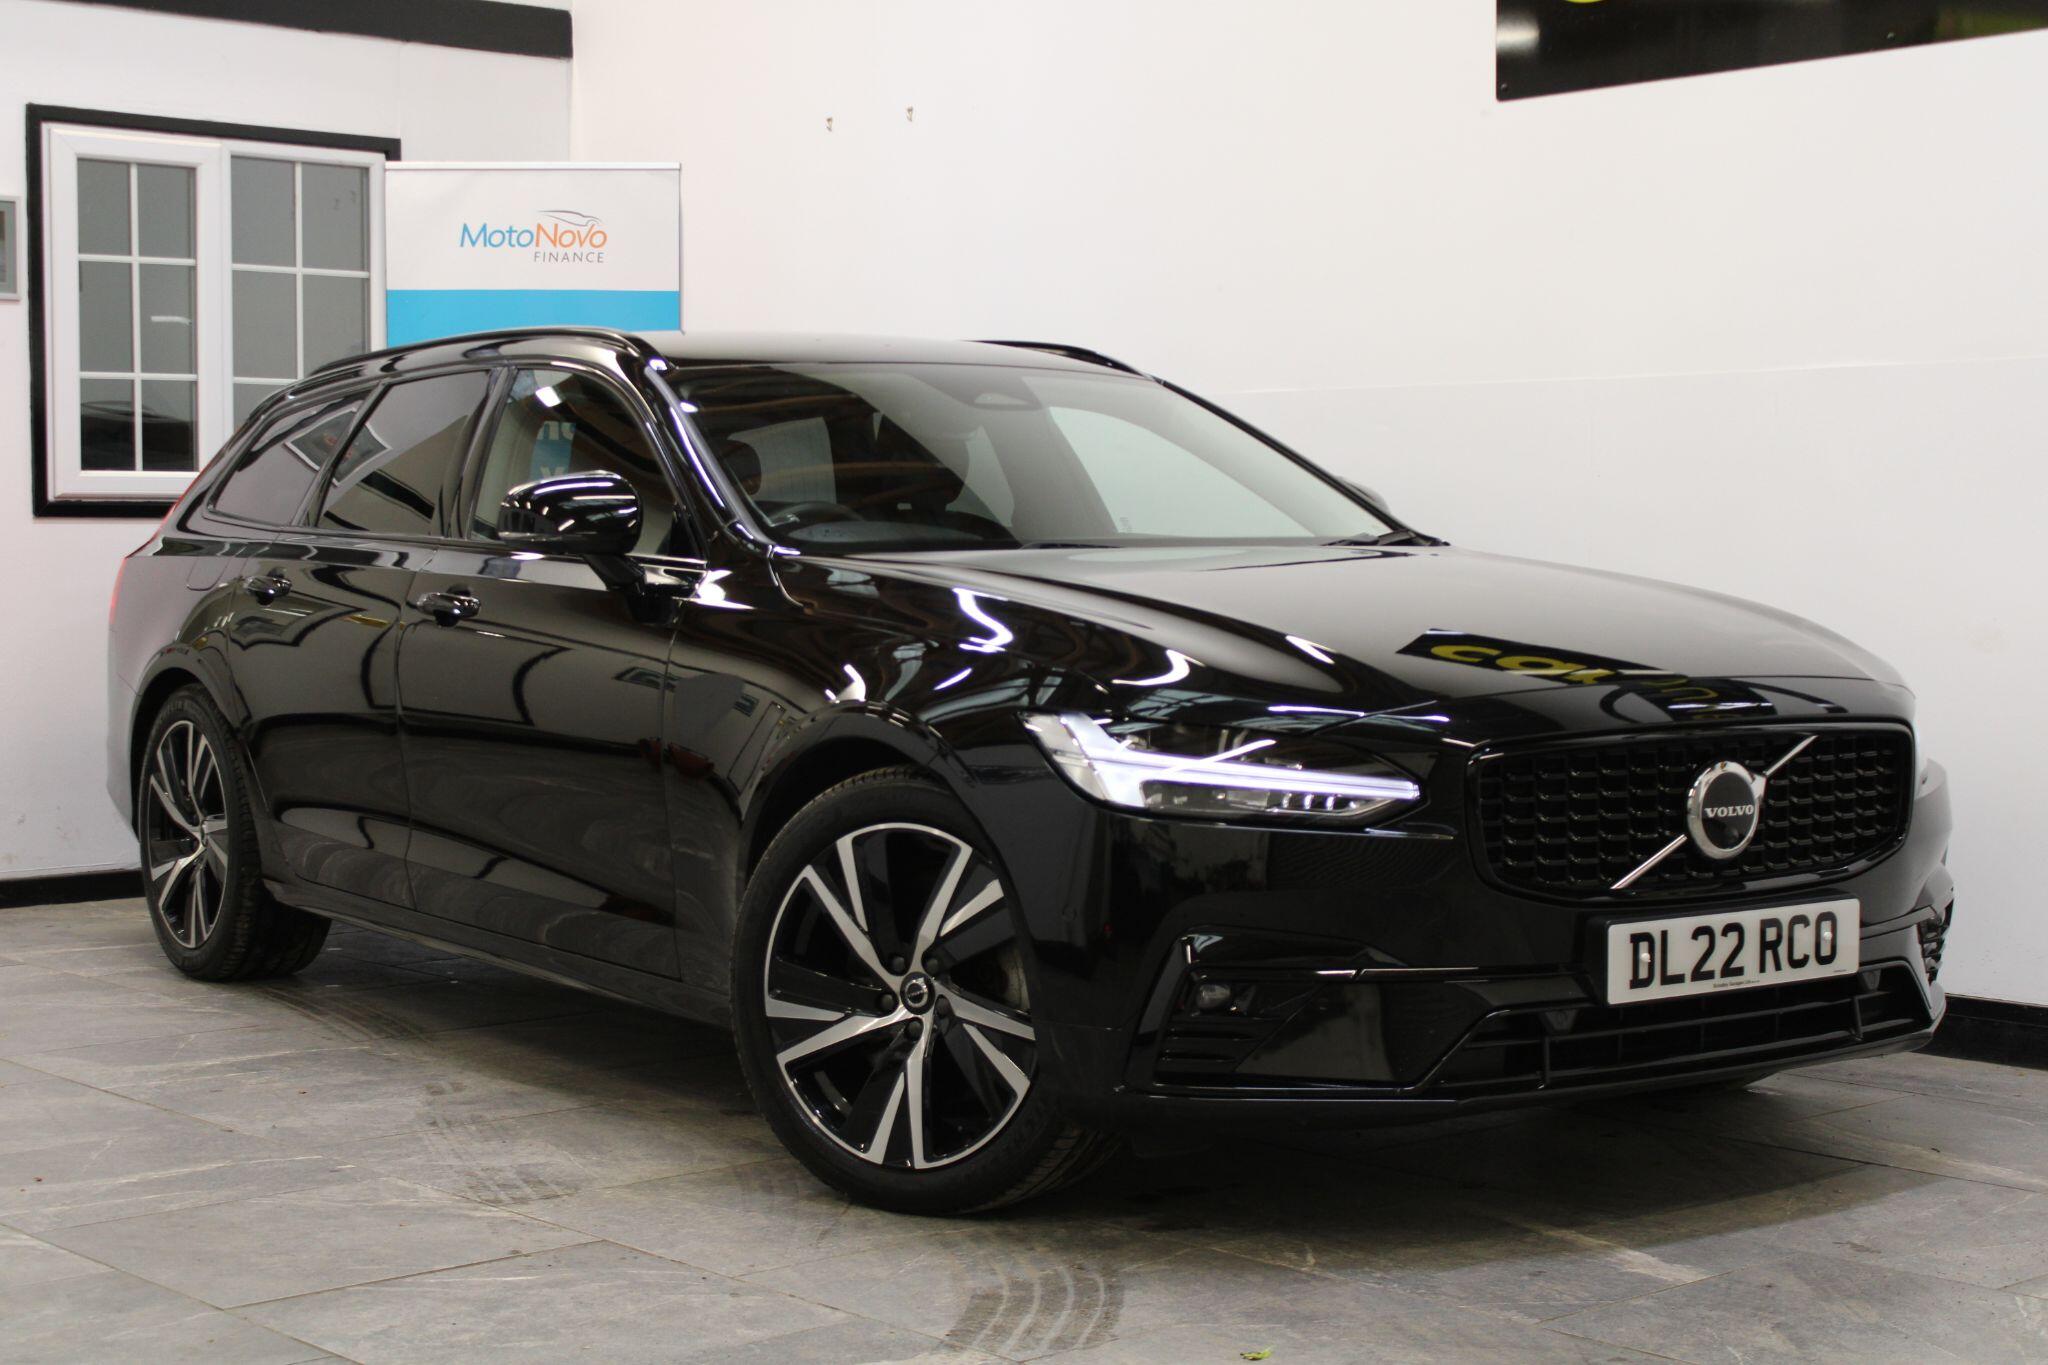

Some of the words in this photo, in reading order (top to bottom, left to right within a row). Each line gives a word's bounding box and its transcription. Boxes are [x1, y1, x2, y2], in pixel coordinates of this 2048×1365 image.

[460, 222, 607, 249] MotoNovo
[534, 252, 605, 264] FINANCE
[1704, 804, 1754, 818] VOLVO
[1629, 922, 1745, 989] DL22
[1759, 911, 1837, 973] RCO
